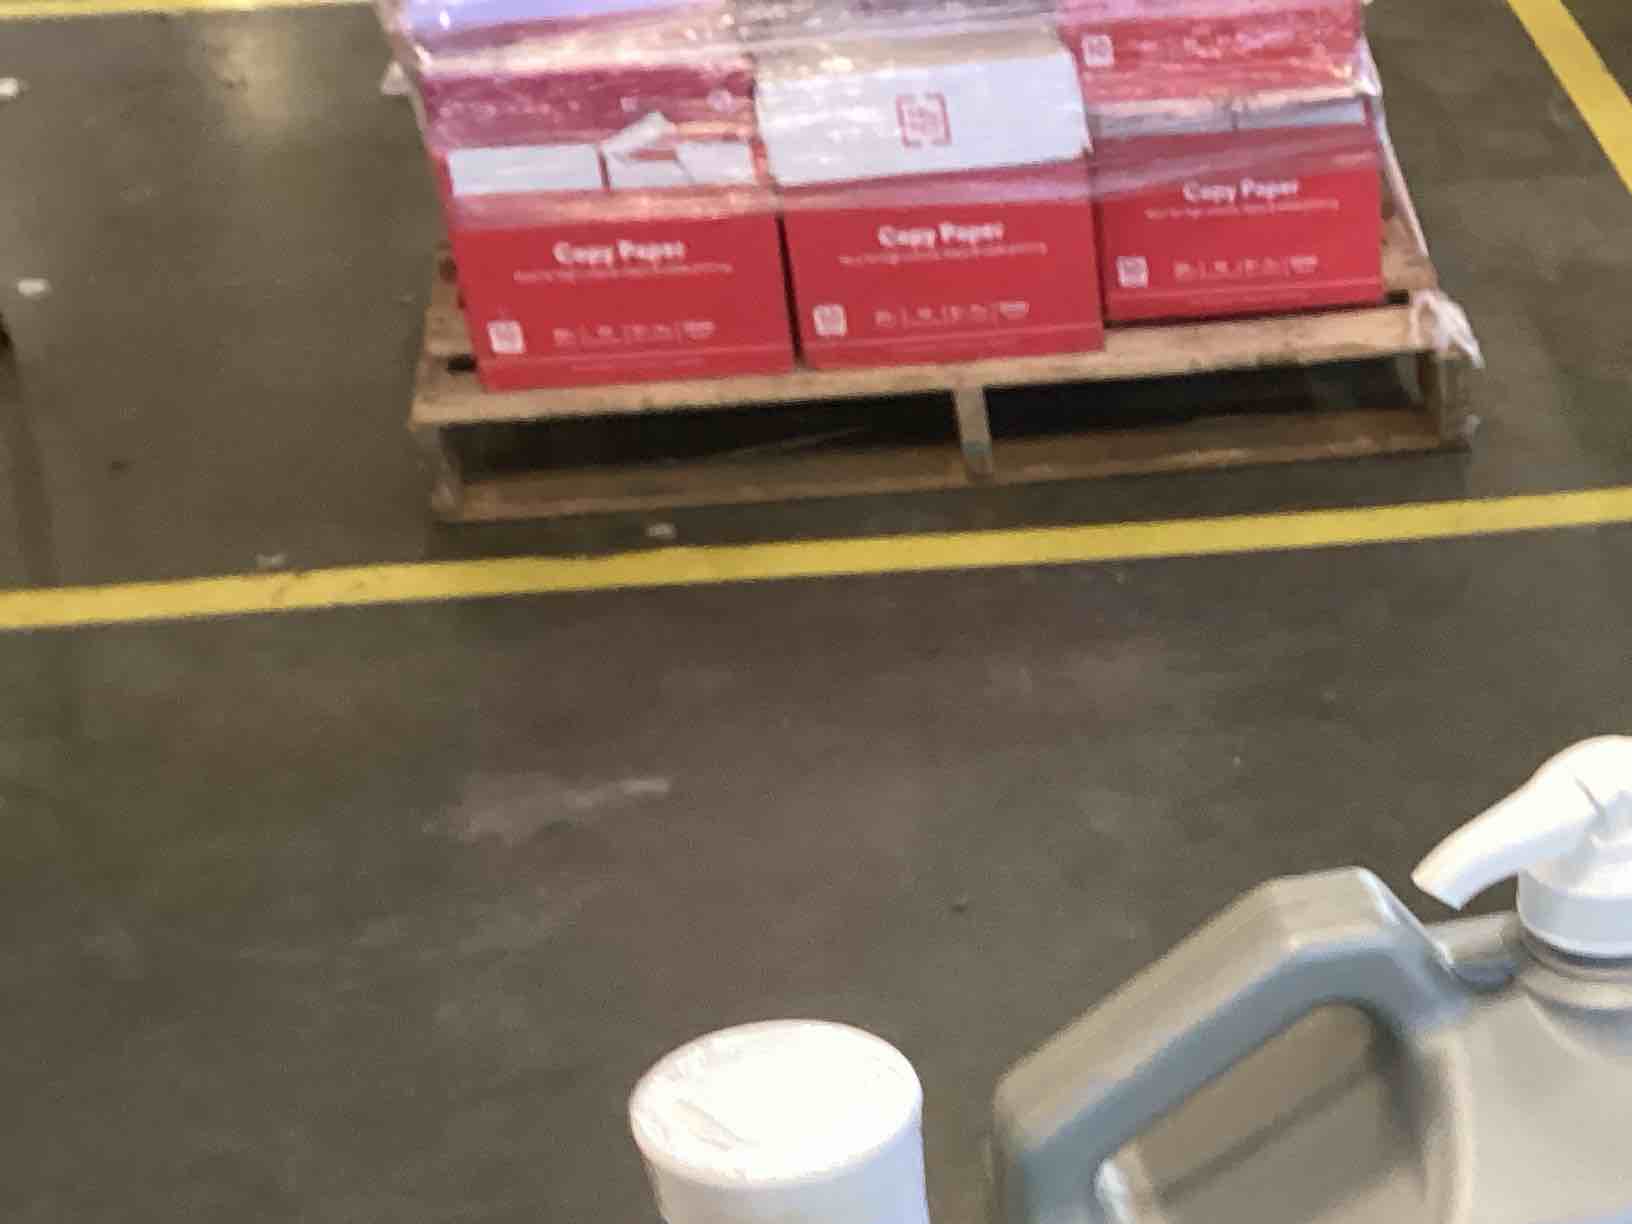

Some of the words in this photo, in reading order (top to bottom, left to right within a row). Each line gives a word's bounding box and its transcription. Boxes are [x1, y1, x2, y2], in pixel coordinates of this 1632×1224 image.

[1182, 180, 1236, 205] Copy
[1239, 177, 1299, 203] Paper
[877, 224, 936, 250] Copy
[938, 220, 1004, 249] Paper
[552, 241, 614, 268] Copy
[617, 239, 687, 266] Paper
